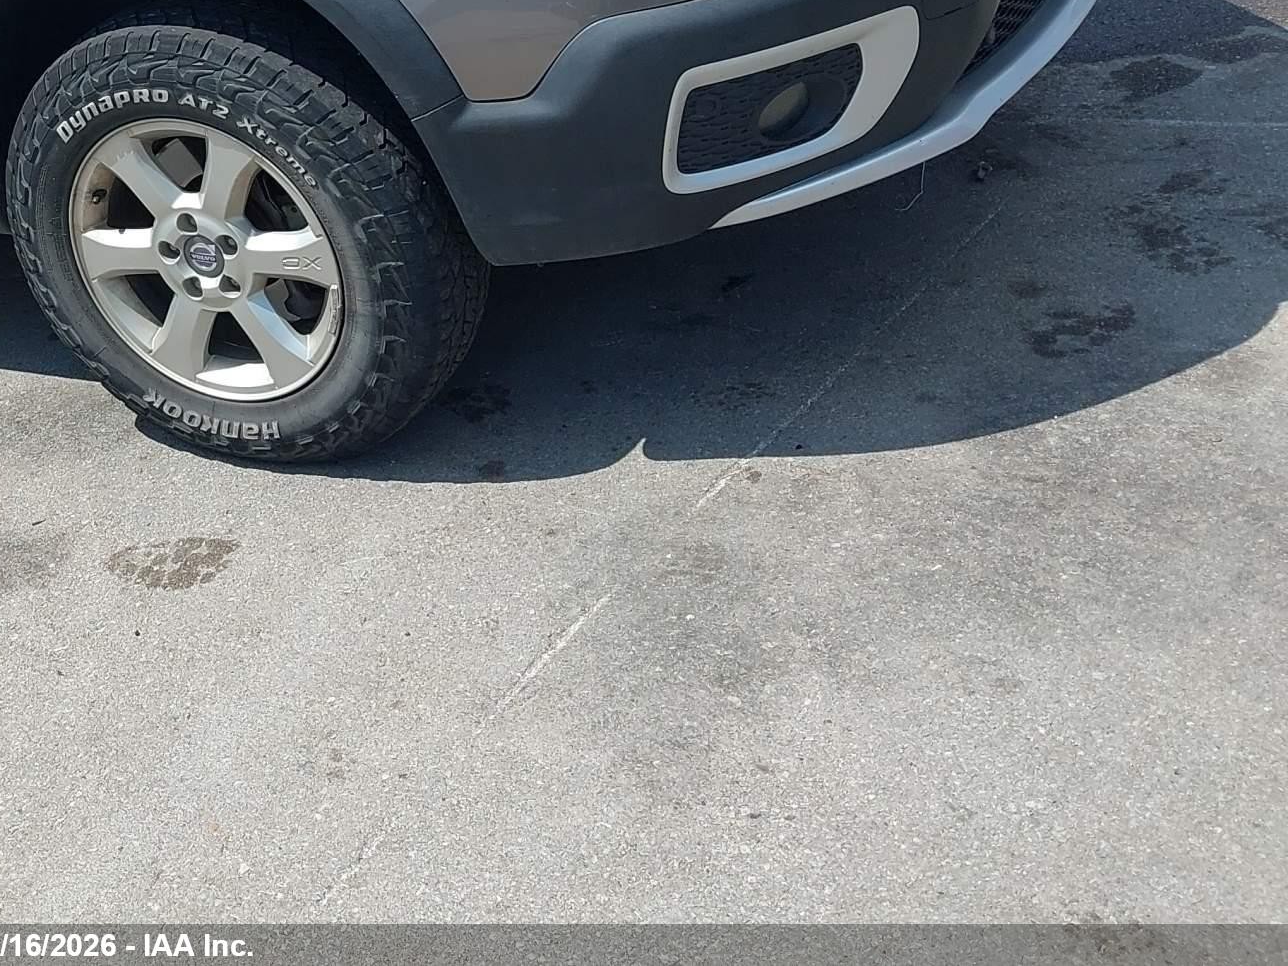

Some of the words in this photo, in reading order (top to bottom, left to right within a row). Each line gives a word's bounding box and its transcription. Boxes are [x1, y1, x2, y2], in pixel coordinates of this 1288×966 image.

[177, 93, 231, 120] AT2
[236, 114, 317, 188] Xtreme
[190, 252, 216, 262] VOLVO
